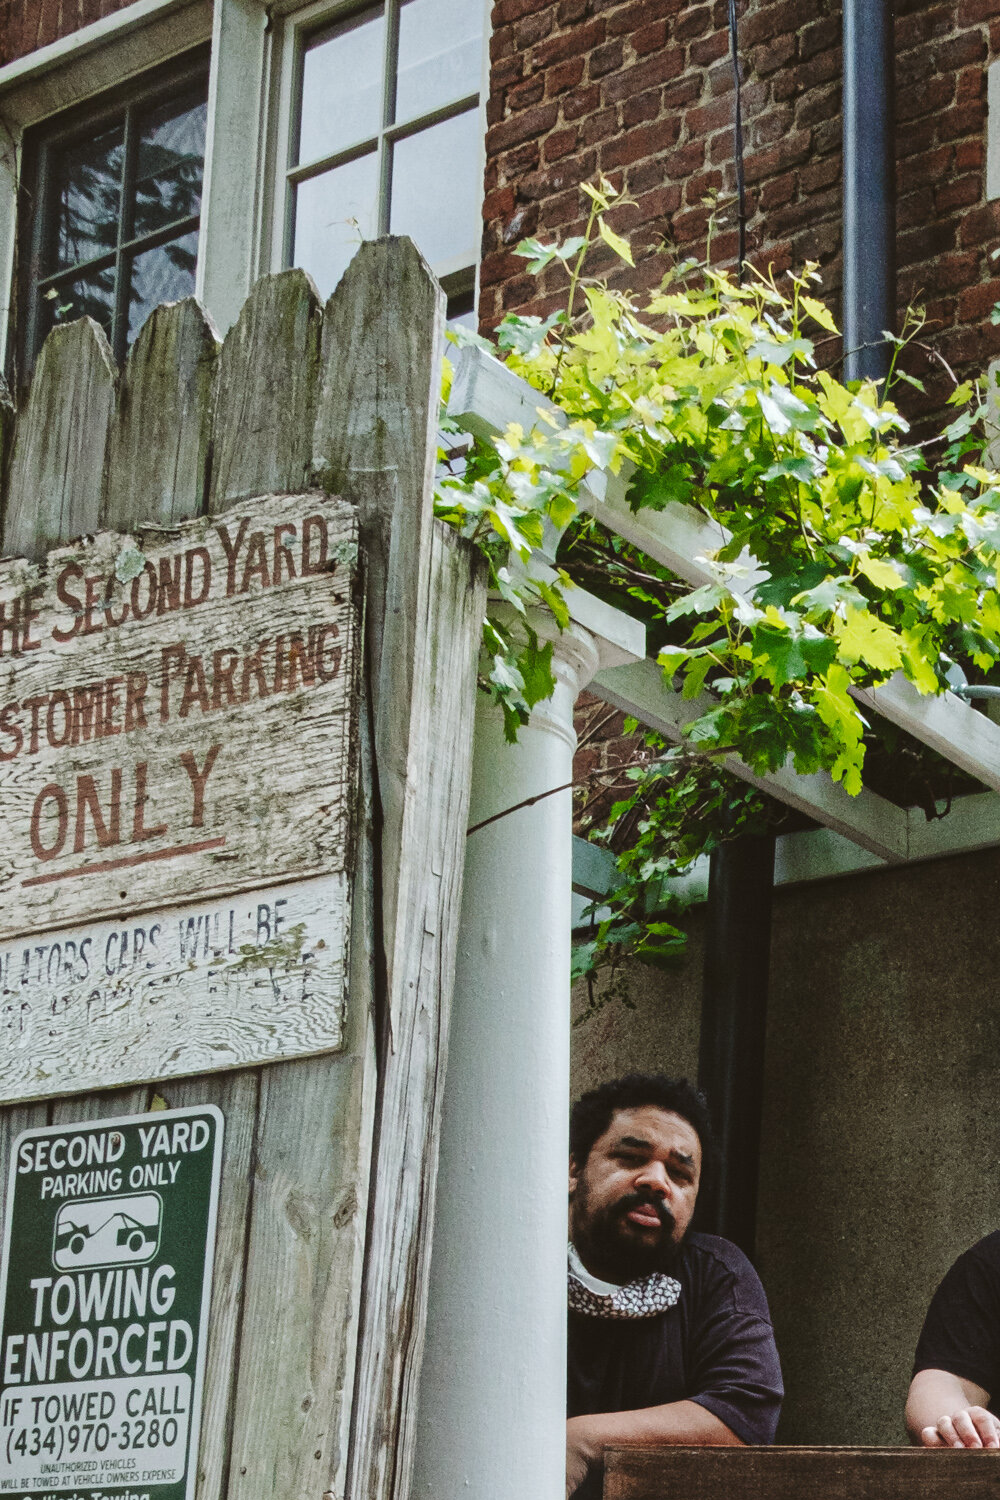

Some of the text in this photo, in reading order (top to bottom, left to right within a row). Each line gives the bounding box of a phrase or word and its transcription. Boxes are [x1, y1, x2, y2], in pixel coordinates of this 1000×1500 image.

[52, 546, 212, 643] SECOND
[216, 514, 337, 598] YARD
[160, 622, 342, 723] PARKING
[30, 744, 224, 862] ONLY
[0, 937, 92, 995] LATORS
[18, 1120, 210, 1175] SECOND YARD
[41, 1160, 182, 1199] PARKING ONLY
[30, 1264, 177, 1327] TOWING
[4, 1319, 194, 1384] ENFORCED
[3, 1385, 186, 1427] IF TOWED CALL
[6, 1418, 178, 1464] (434)970-3280
[40, 1458, 137, 1474] UNAUTHORIZED VEHICLES
[1, 1469, 177, 1490] WILL BE TOWED AT VEHICLE OWNERS EXPENSE
